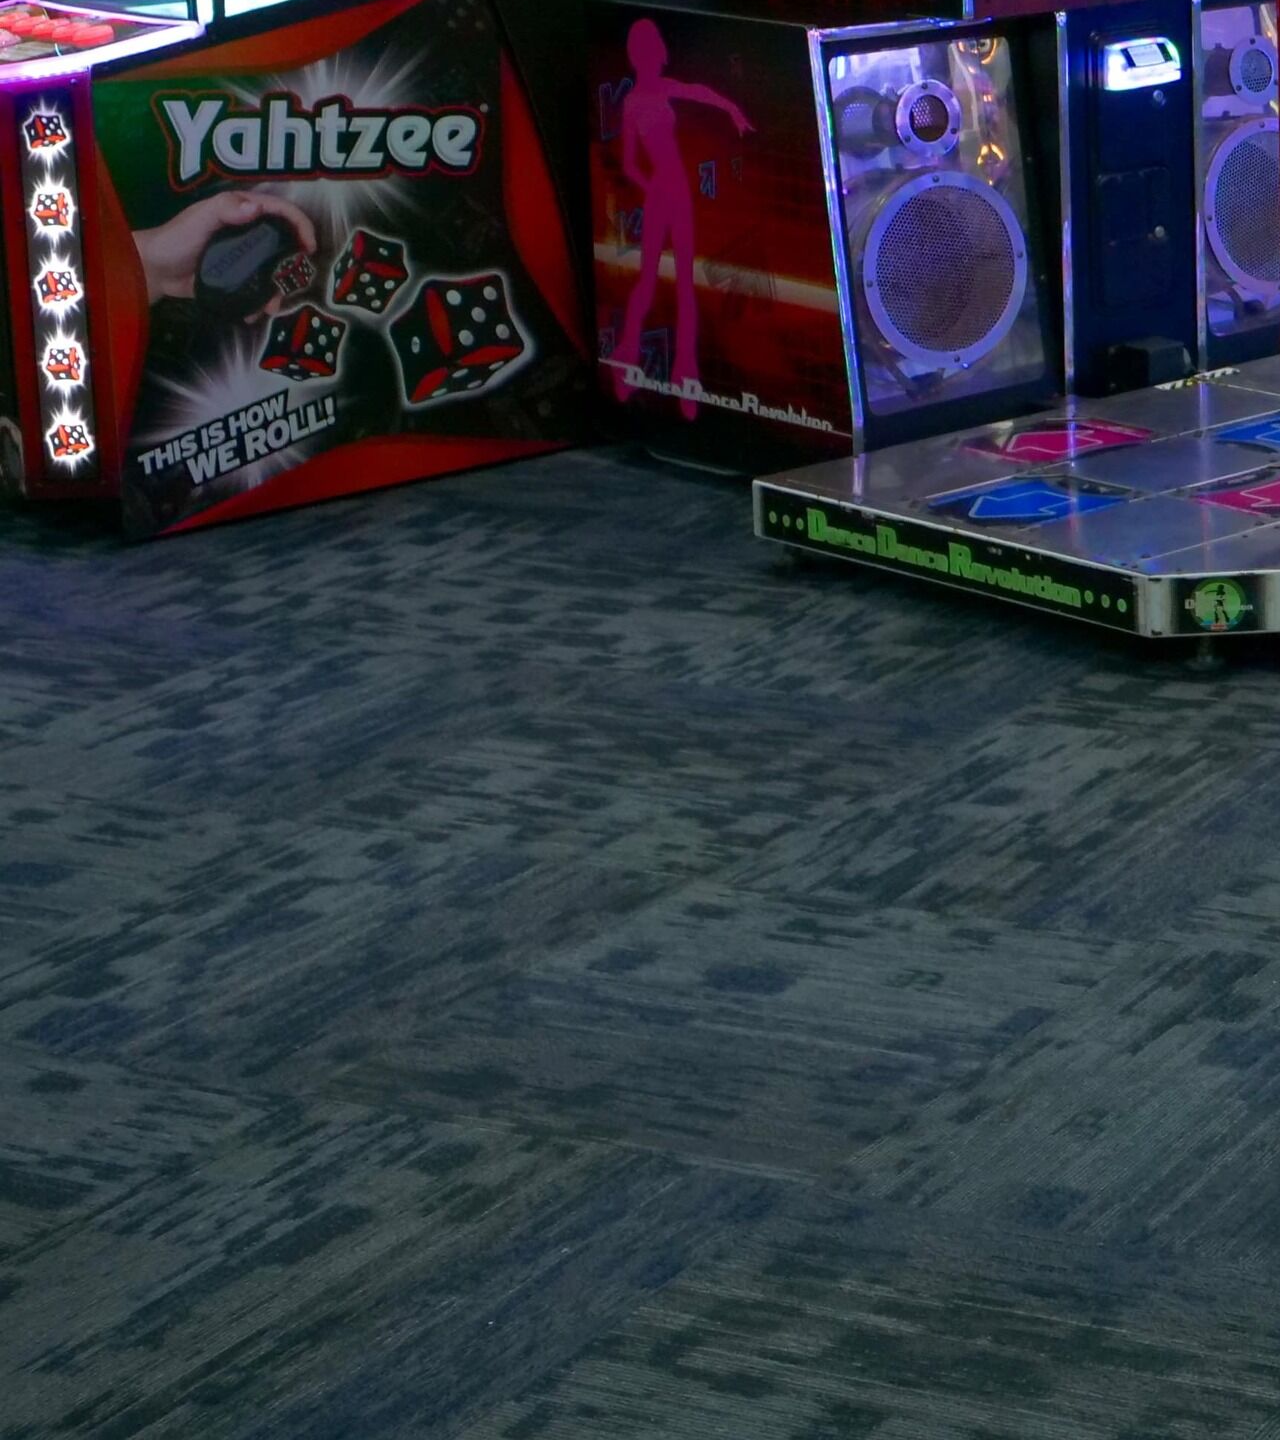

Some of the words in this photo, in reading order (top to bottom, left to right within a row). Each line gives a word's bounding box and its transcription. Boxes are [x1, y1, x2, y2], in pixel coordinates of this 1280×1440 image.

[162, 99, 477, 181] Yahtzee
[138, 433, 198, 475] THIS
[202, 421, 226, 450] IS
[228, 394, 286, 438] HOW
[186, 439, 240, 486] WE
[245, 396, 336, 462] ROLL!
